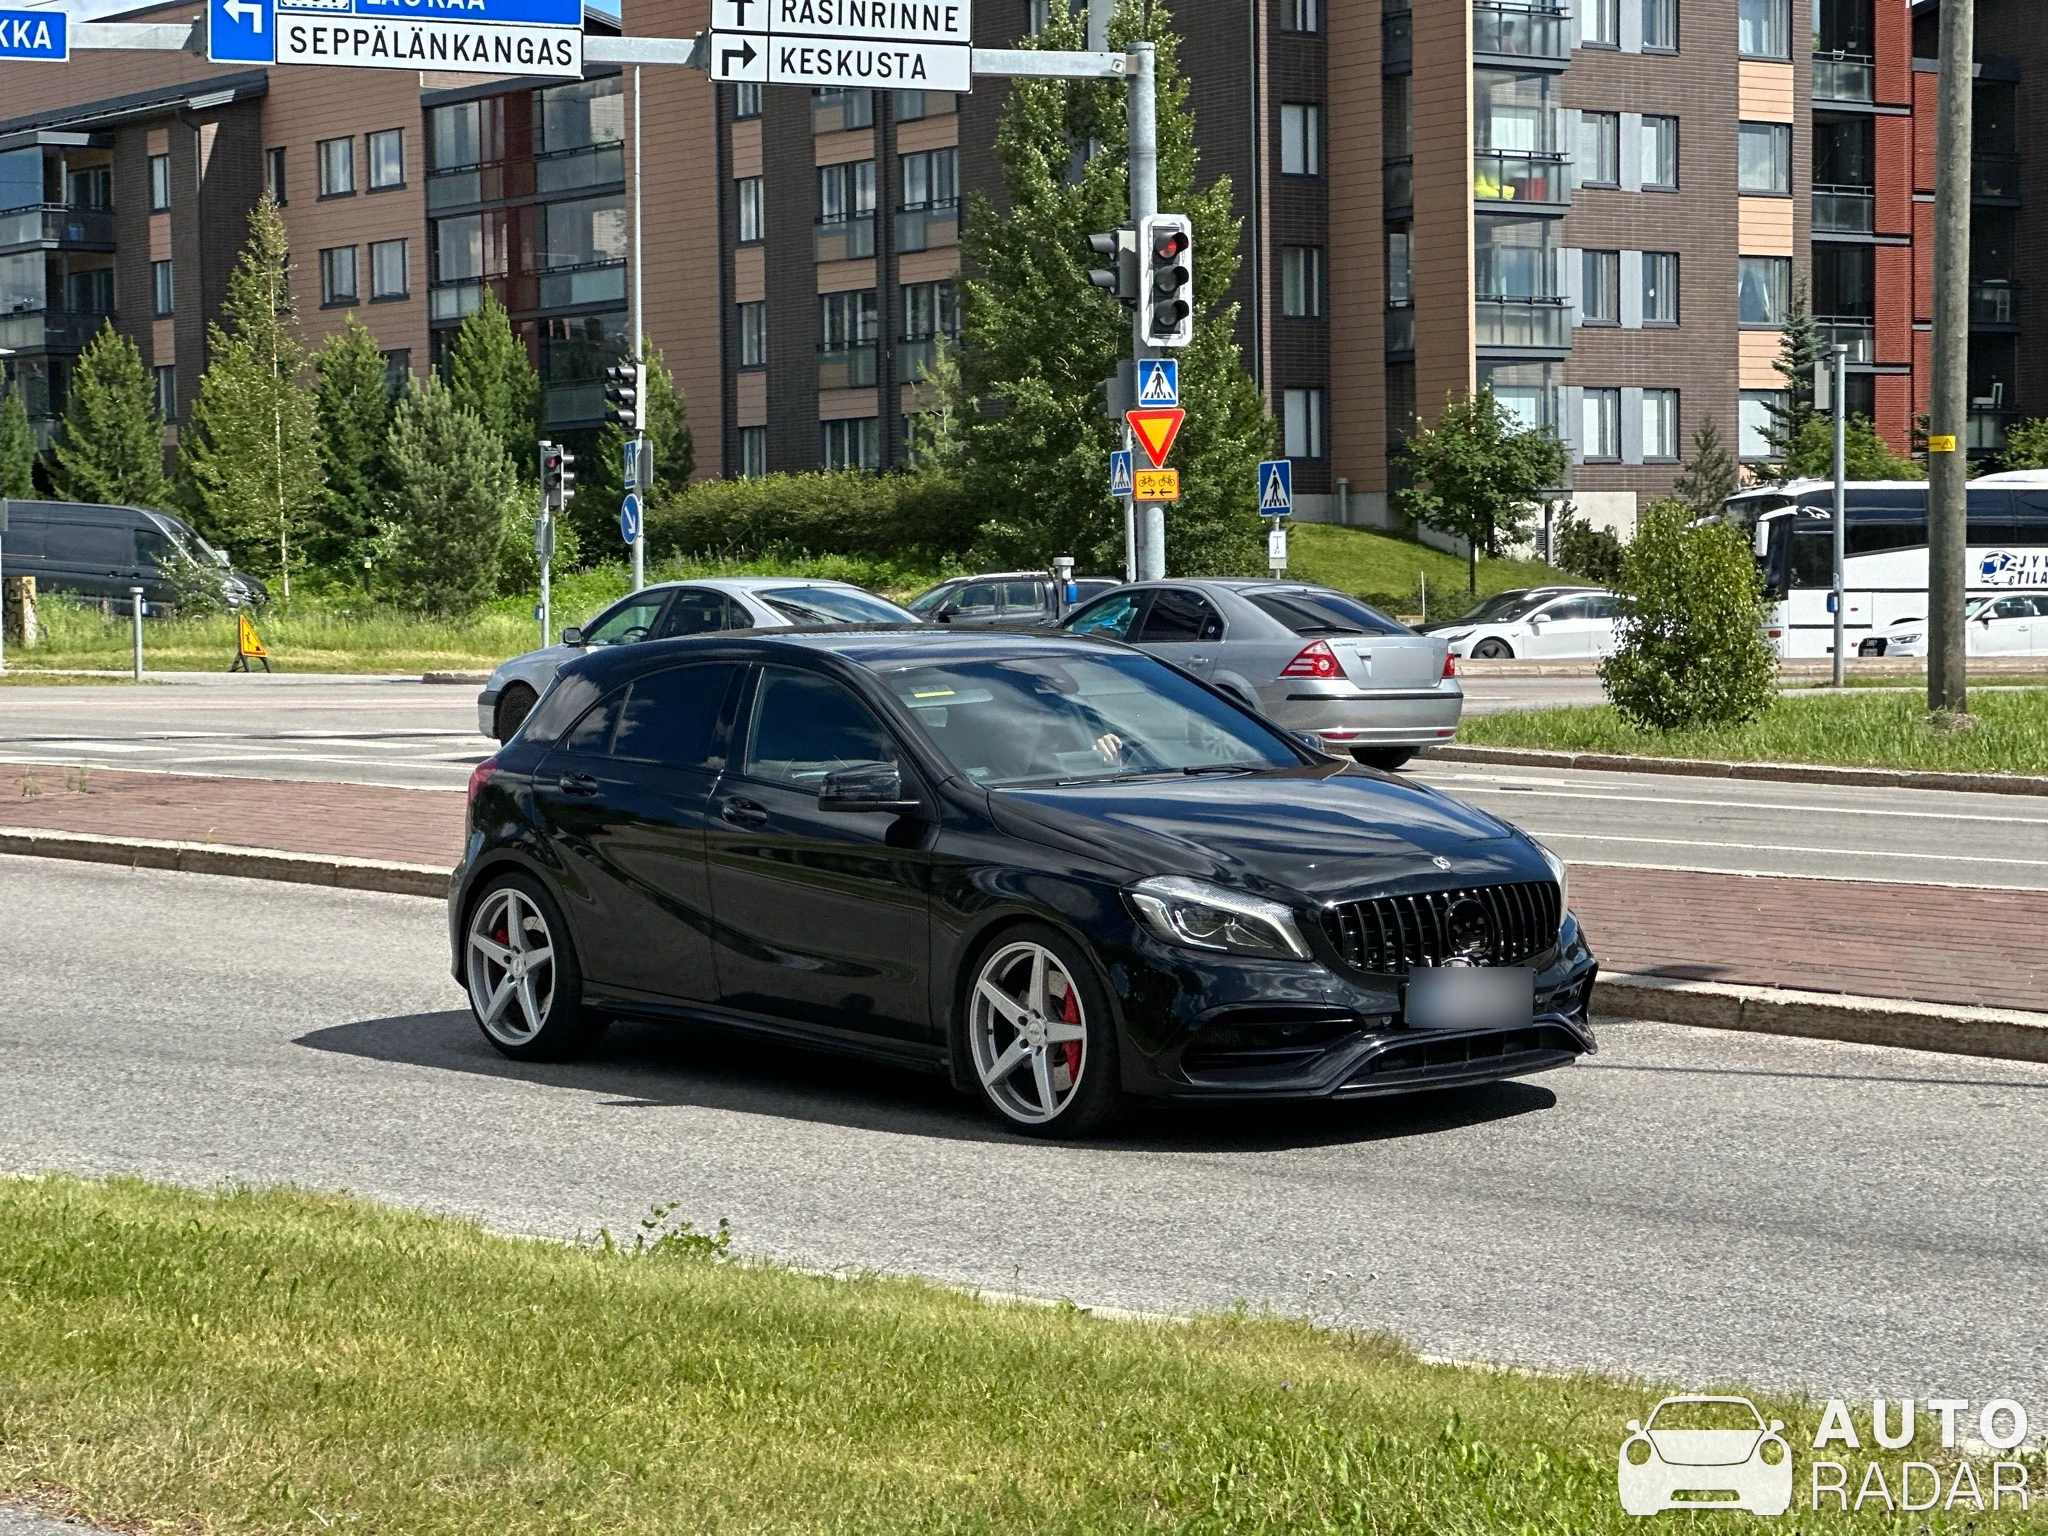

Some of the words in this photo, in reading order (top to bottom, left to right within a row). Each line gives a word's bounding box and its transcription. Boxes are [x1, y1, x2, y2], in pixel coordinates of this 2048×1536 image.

[781, 0, 959, 32] RASINRINNE
[289, 25, 573, 66] SEPPÄLÄNKANGAS
[780, 46, 927, 80] KESKUSTA
